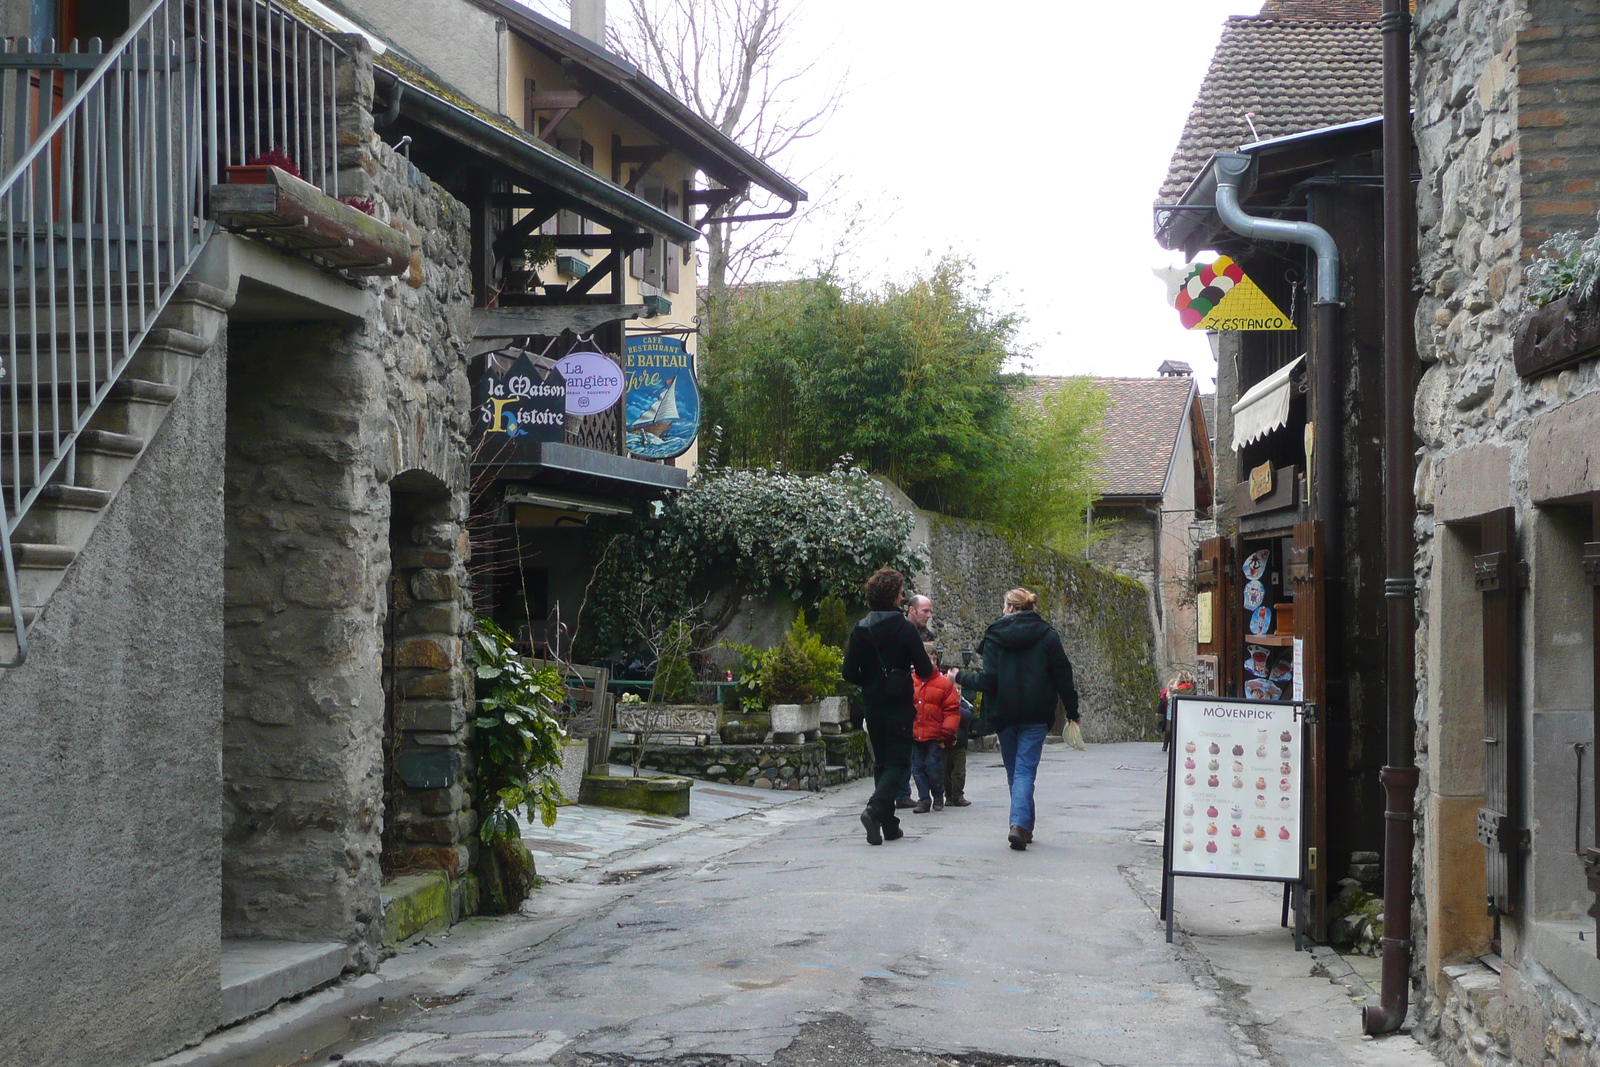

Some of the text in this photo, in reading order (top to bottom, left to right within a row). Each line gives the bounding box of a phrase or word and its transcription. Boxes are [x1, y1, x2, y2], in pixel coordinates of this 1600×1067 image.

[627, 344, 679, 354] RESTAURANT
[625, 354, 688, 368] E BATEAU
[564, 362, 584, 375] La
[487, 374, 566, 400] la Maison
[564, 375, 618, 390] angière
[1203, 704, 1273, 720] MÖVENPICK
